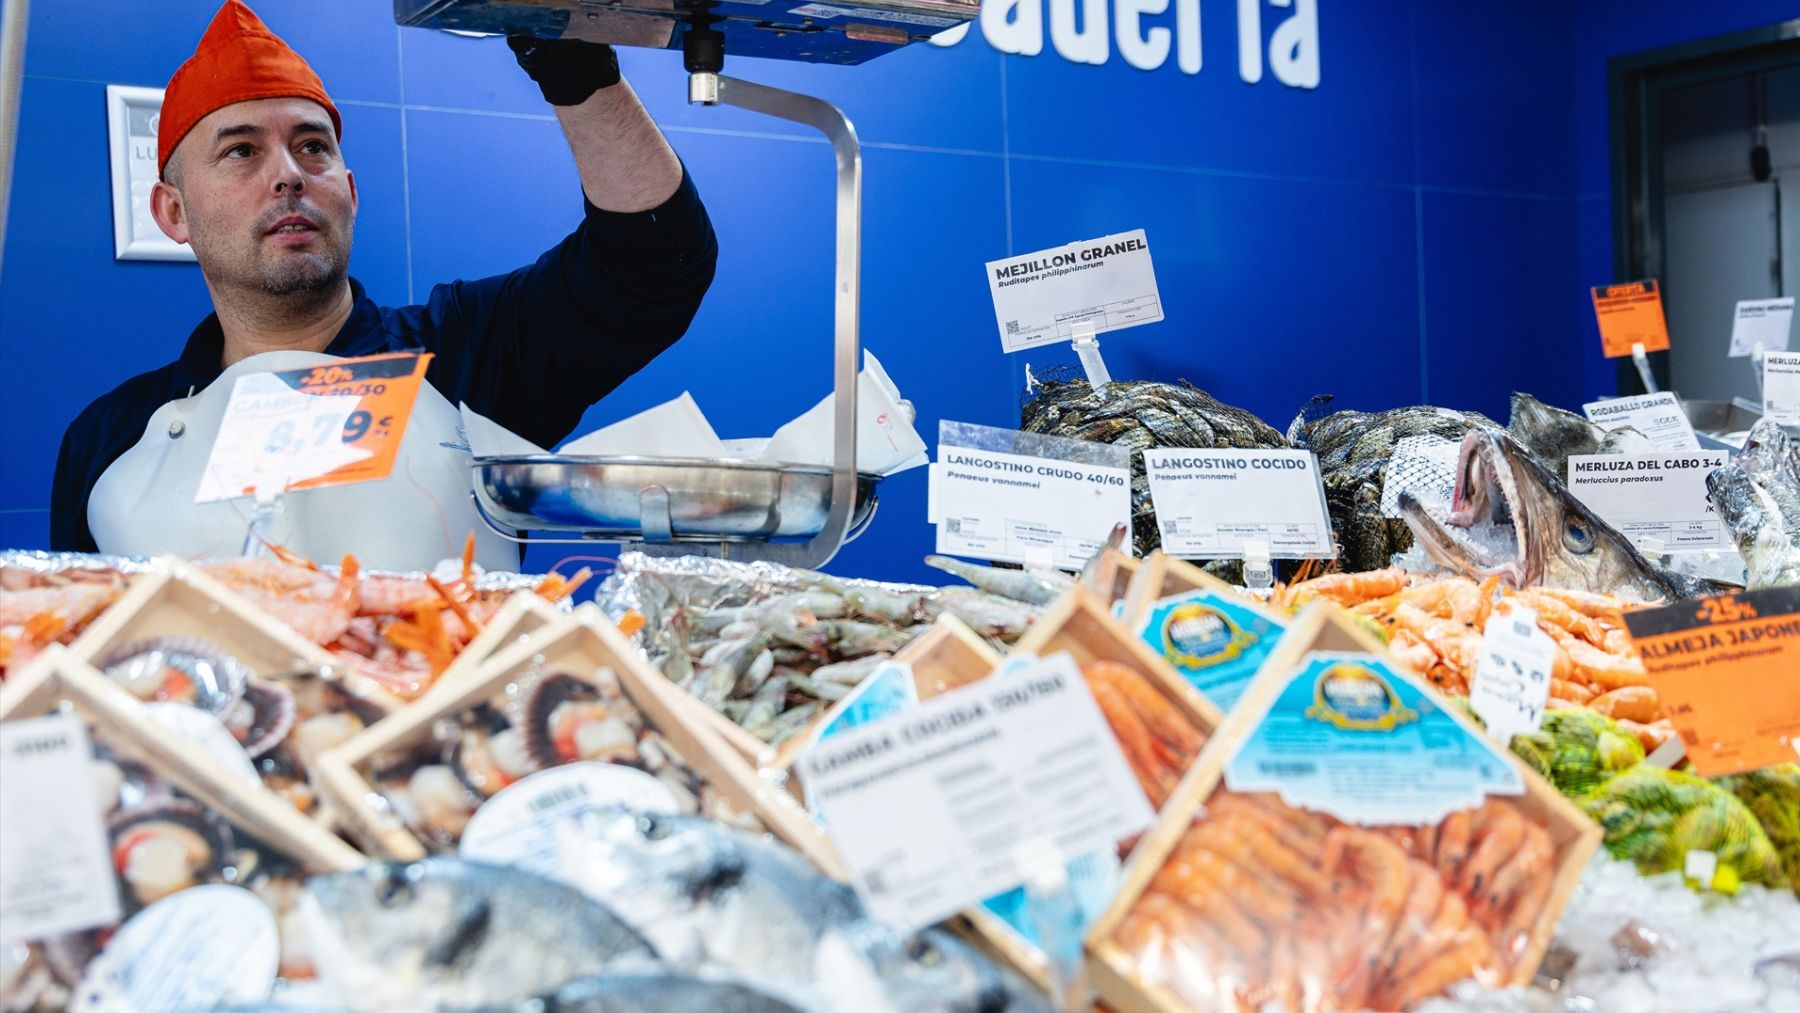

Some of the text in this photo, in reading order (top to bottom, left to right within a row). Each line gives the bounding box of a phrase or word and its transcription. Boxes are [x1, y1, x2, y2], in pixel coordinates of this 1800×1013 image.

[995, 238, 1147, 280] MEJILLON GRANEL
[998, 273, 1040, 289] Ruditapes
[947, 454, 1125, 487] LANGOSTINO CRUDO 40/60
[1152, 458, 1307, 471] LANGOSTINO COCIDO
[1575, 458, 1723, 473] MERLUZA DEL CABO 3-4
[947, 470, 1041, 489] Penaeus vannamei
[1155, 472, 1237, 482] Penaeus vannamei
[1575, 475, 1664, 485] Merluccius paradoxus
[1695, 597, 1758, 624] -25%
[1639, 633, 1726, 660] ALMEJA
